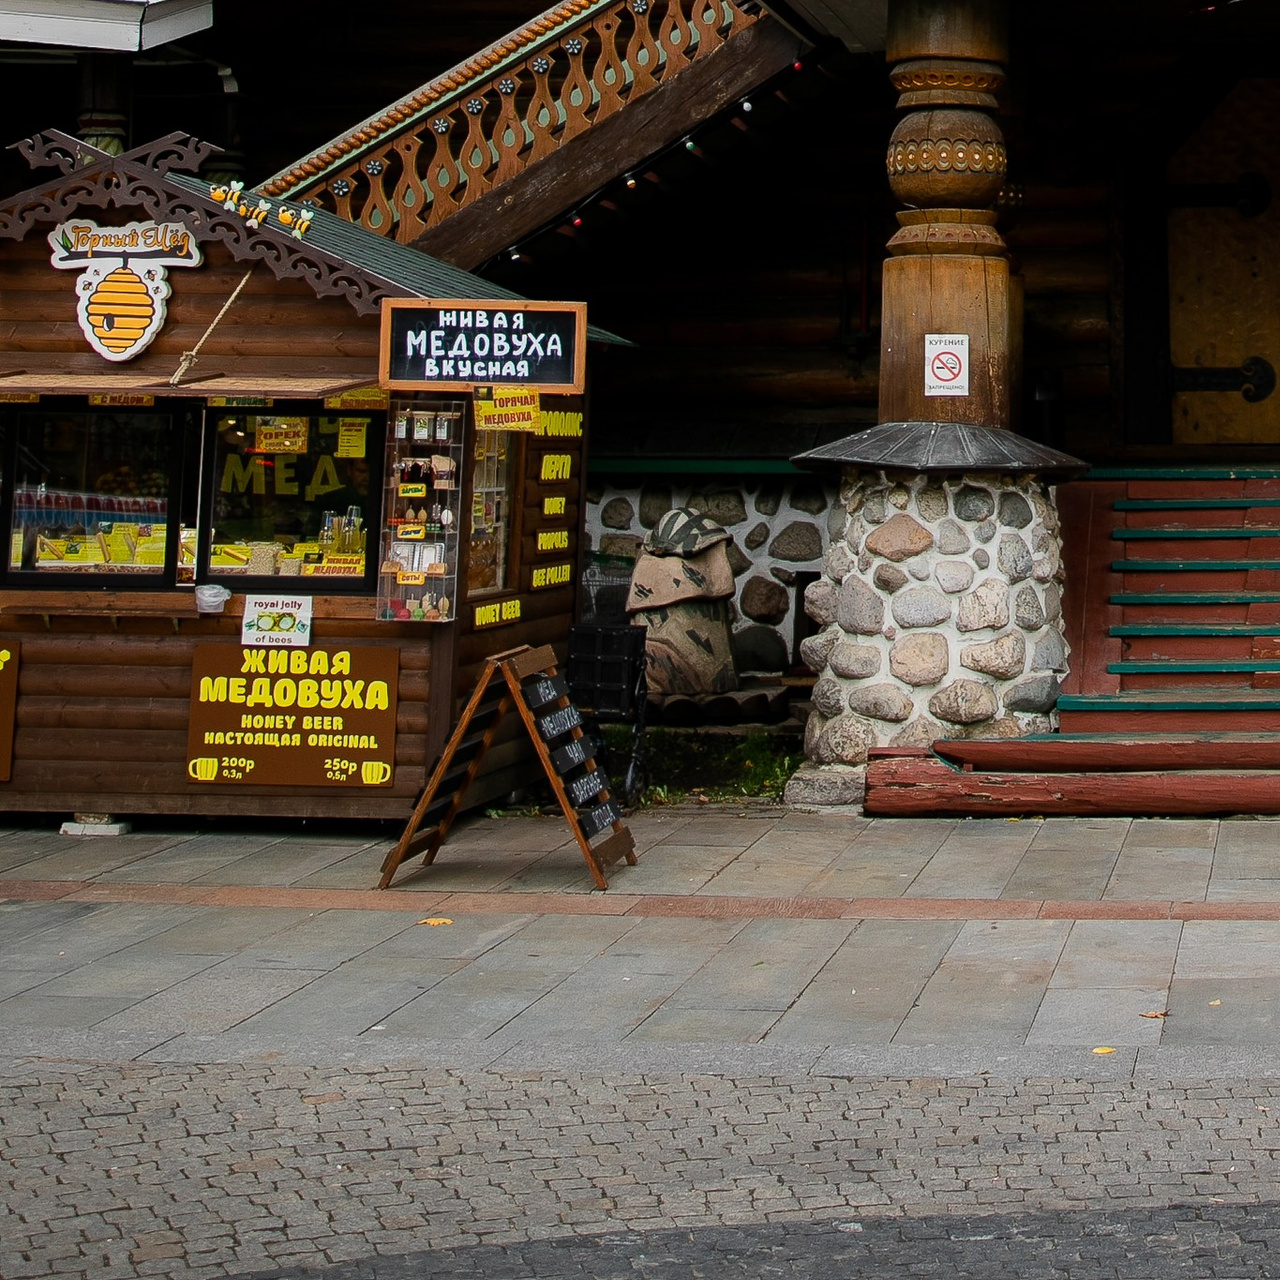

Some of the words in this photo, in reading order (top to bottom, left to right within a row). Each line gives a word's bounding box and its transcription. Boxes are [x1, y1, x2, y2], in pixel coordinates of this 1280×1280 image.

[72, 226, 140, 258] Горный
[141, 225, 190, 256] Мёд
[438, 310, 524, 329] ЖИВАЯ
[406, 330, 562, 358] МЕДОВУХА
[425, 359, 529, 377] ВКУСНАЯ
[493, 394, 537, 409] ГОРЯЧАЯ
[484, 411, 533, 426] МЕДОВУХА
[219, 453, 347, 502] МЕД
[544, 497, 566, 515] HONEY
[538, 531, 568, 551] PROPOLIS
[314, 565, 357, 575] МЕДОВУХА
[533, 567, 547, 588] BEE
[547, 564, 571, 585] POLLEN
[254, 600, 279, 609] royal
[280, 600, 303, 610] jelly
[475, 603, 500, 626] HONEY
[502, 600, 521, 620] BEER
[255, 635, 266, 644] of
[268, 635, 293, 644] bees
[240, 648, 351, 675] ЖИВАЯ
[199, 676, 389, 710] МЕДОВУХА
[241, 714, 297, 730] HONEY
[302, 716, 344, 731] BEER
[204, 731, 301, 748] НАСТОЯЩАЯ
[307, 734, 379, 749] ORIGINAL
